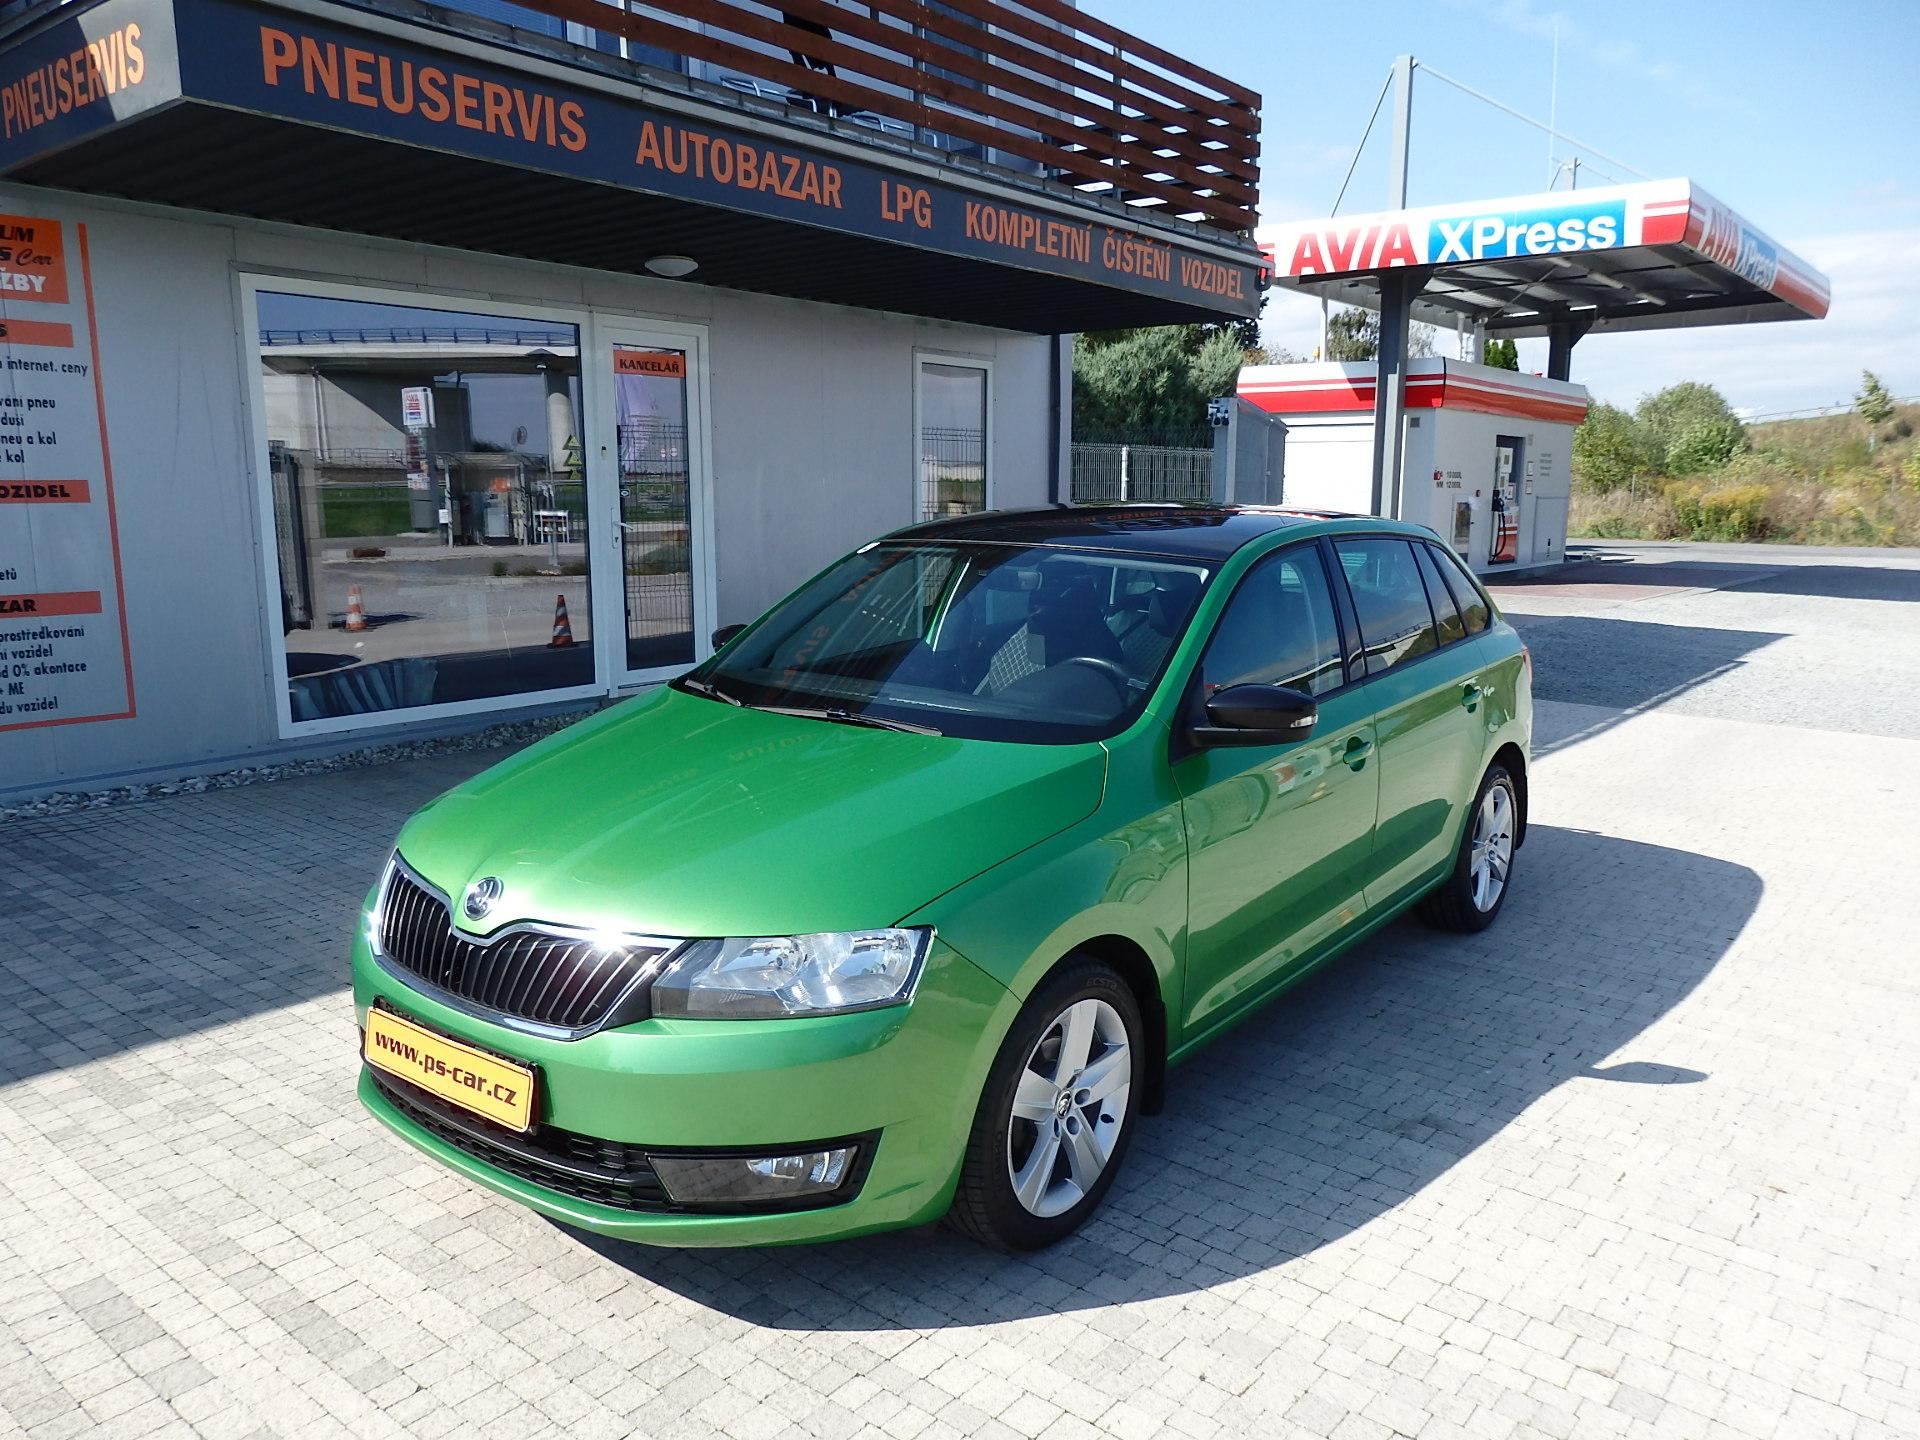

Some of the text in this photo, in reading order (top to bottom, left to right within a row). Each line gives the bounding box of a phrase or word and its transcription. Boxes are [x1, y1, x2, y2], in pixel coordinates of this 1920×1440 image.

[2, 22, 145, 138] PNEUSERVIS
[260, 27, 587, 152] PNEUSERVIS
[635, 120, 842, 209] AUTOBAZAR
[881, 180, 932, 229] LPG
[965, 202, 1245, 299] KOMPLETNÍ ČIŠTĚNÍ VOZIDEL
[1289, 215, 1617, 277] AVIA XPress
[16, 248, 53, 266] Car
[7, 356, 58, 372] internet.
[61, 363, 88, 377] ceny
[27, 399, 56, 411] pneu
[38, 431, 57, 445] kol
[5, 449, 25, 463] kol
[11, 643, 53, 660] vozidel
[12, 663, 31, 678] 0%
[34, 661, 87, 677] akontace
[16, 695, 59, 713] vozidel
[375, 1031, 518, 1107] www.ps-car.cz
